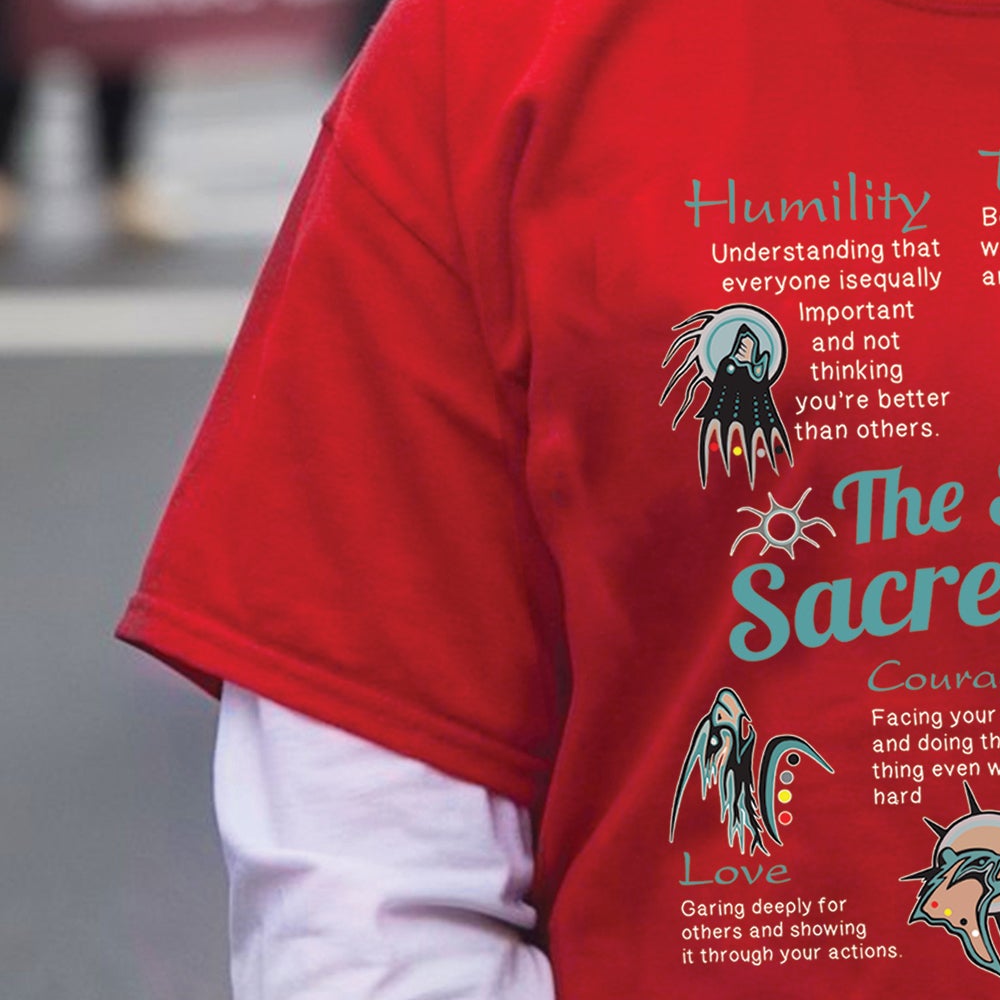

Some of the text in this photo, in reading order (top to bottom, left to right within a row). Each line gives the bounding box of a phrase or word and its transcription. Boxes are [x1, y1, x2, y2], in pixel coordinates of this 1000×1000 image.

[685, 172, 930, 233] Humility
[712, 238, 940, 264] Understanding that
[722, 266, 941, 295] everyone isequally
[799, 301, 914, 325] Important
[812, 331, 900, 352] and not
[810, 360, 903, 384] thinking
[796, 389, 950, 415] you're better
[794, 419, 939, 441] than others.
[833, 466, 964, 544] The
[872, 708, 942, 729] Facing
[950, 709, 995, 728] your
[873, 734, 910, 753] and
[918, 733, 973, 754] doing
[872, 761, 924, 782] thing
[932, 762, 980, 777] even
[874, 786, 921, 805] hard
[680, 852, 790, 885] Love
[681, 897, 846, 919] Garing deeply for
[682, 920, 866, 940] others and showing
[683, 943, 902, 966] it through your actions.
